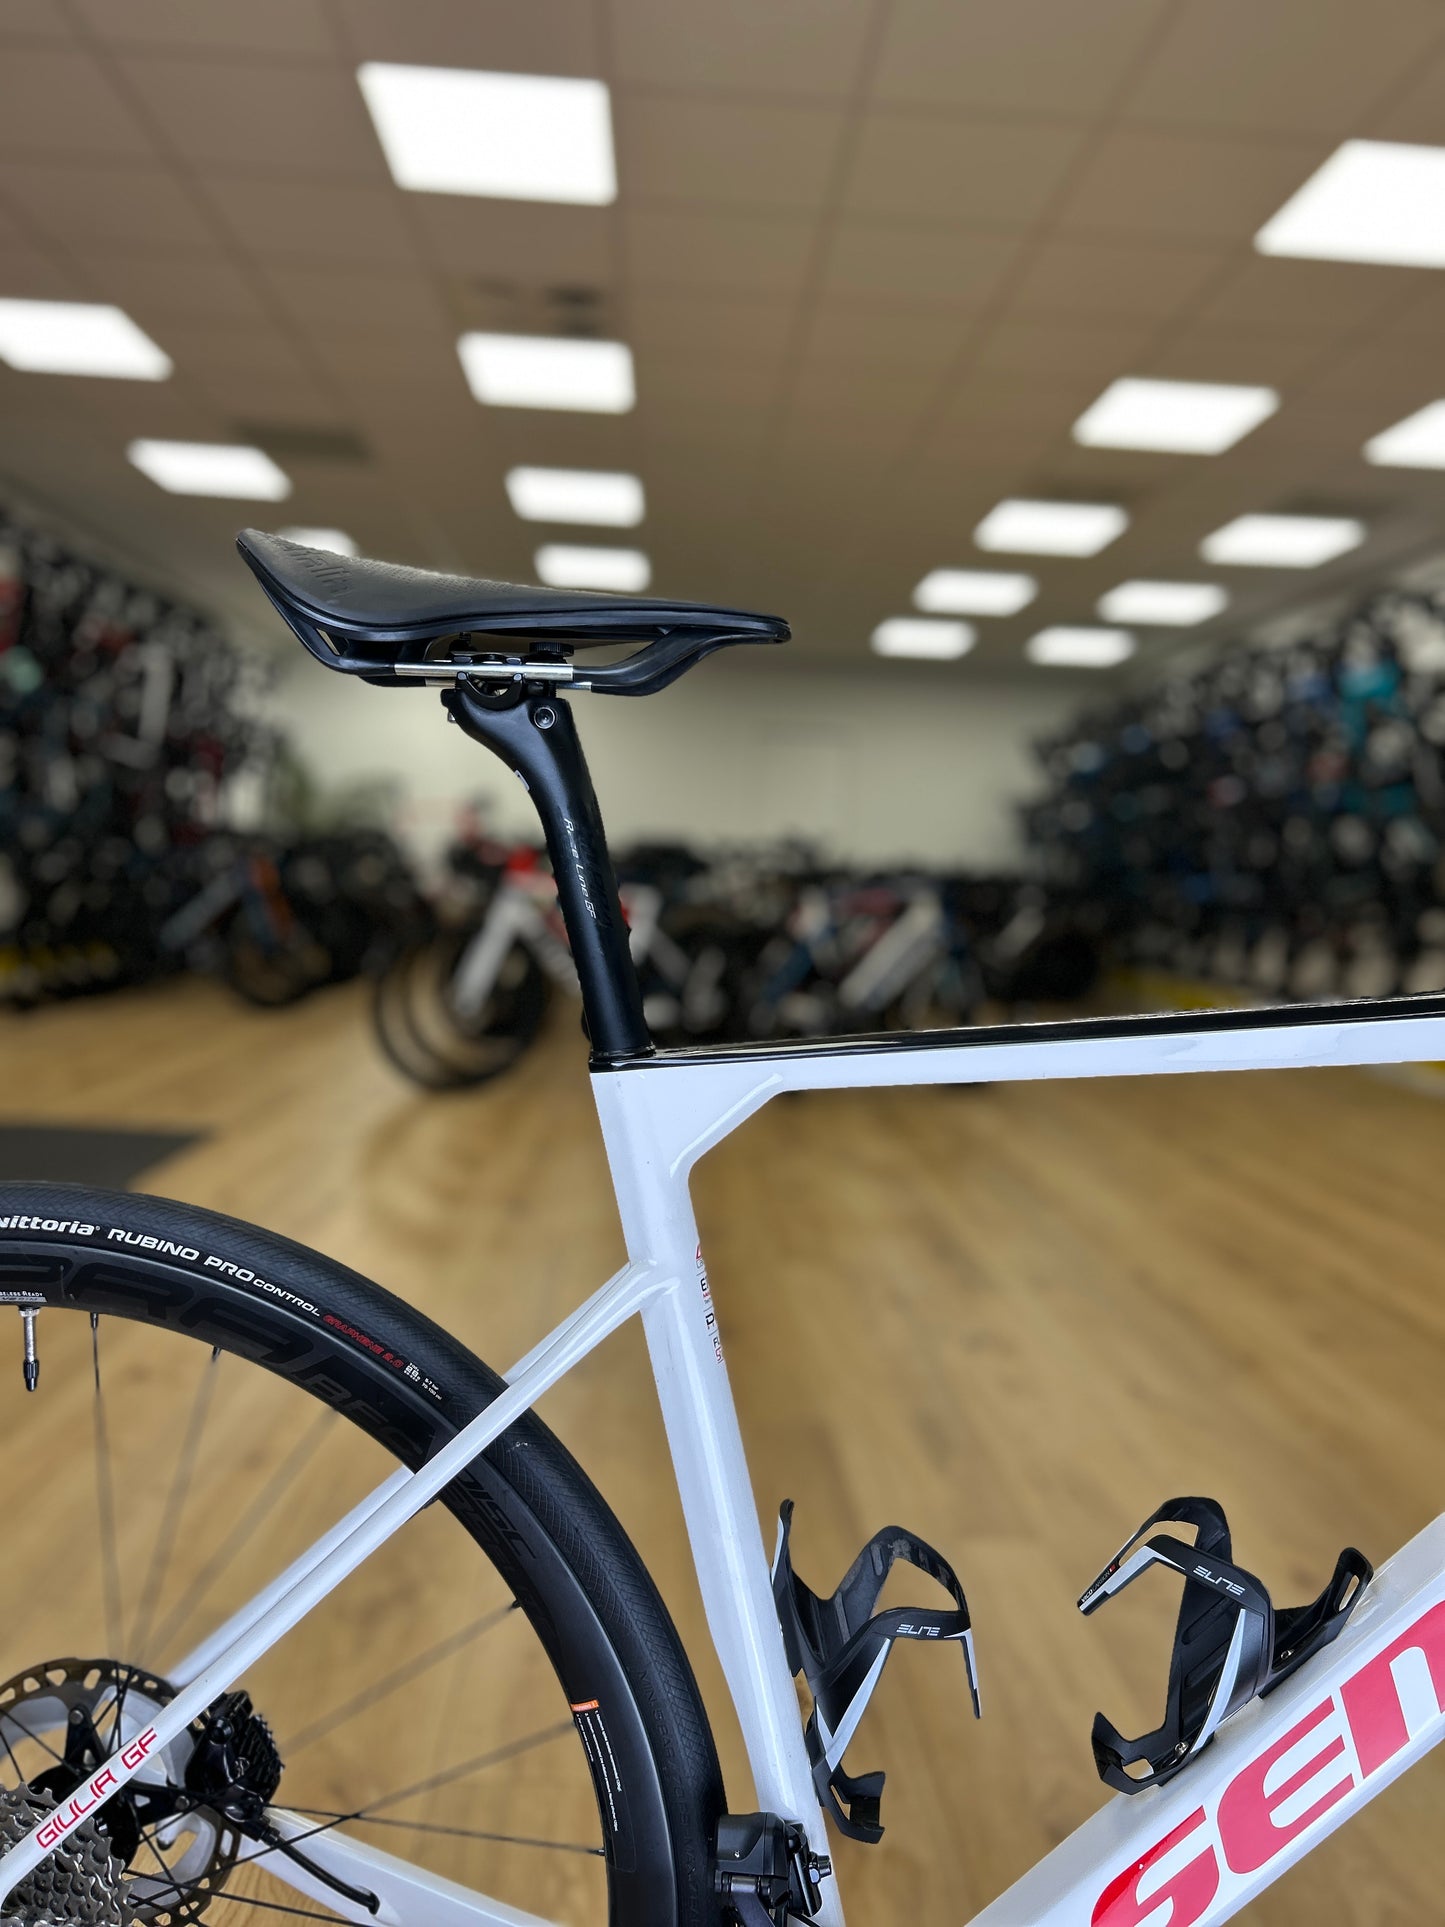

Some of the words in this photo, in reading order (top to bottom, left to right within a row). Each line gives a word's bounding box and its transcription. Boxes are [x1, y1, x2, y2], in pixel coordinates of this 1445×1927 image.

[107, 1228, 199, 1261] RUBINO
[204, 1255, 254, 1282] PRO
[252, 1279, 320, 1316] CONTROL
[1193, 1565, 1245, 1596] ELITE
[896, 1624, 941, 1637] ELITE
[36, 1767, 118, 1848] GIULIA
[121, 1727, 158, 1769] GF
